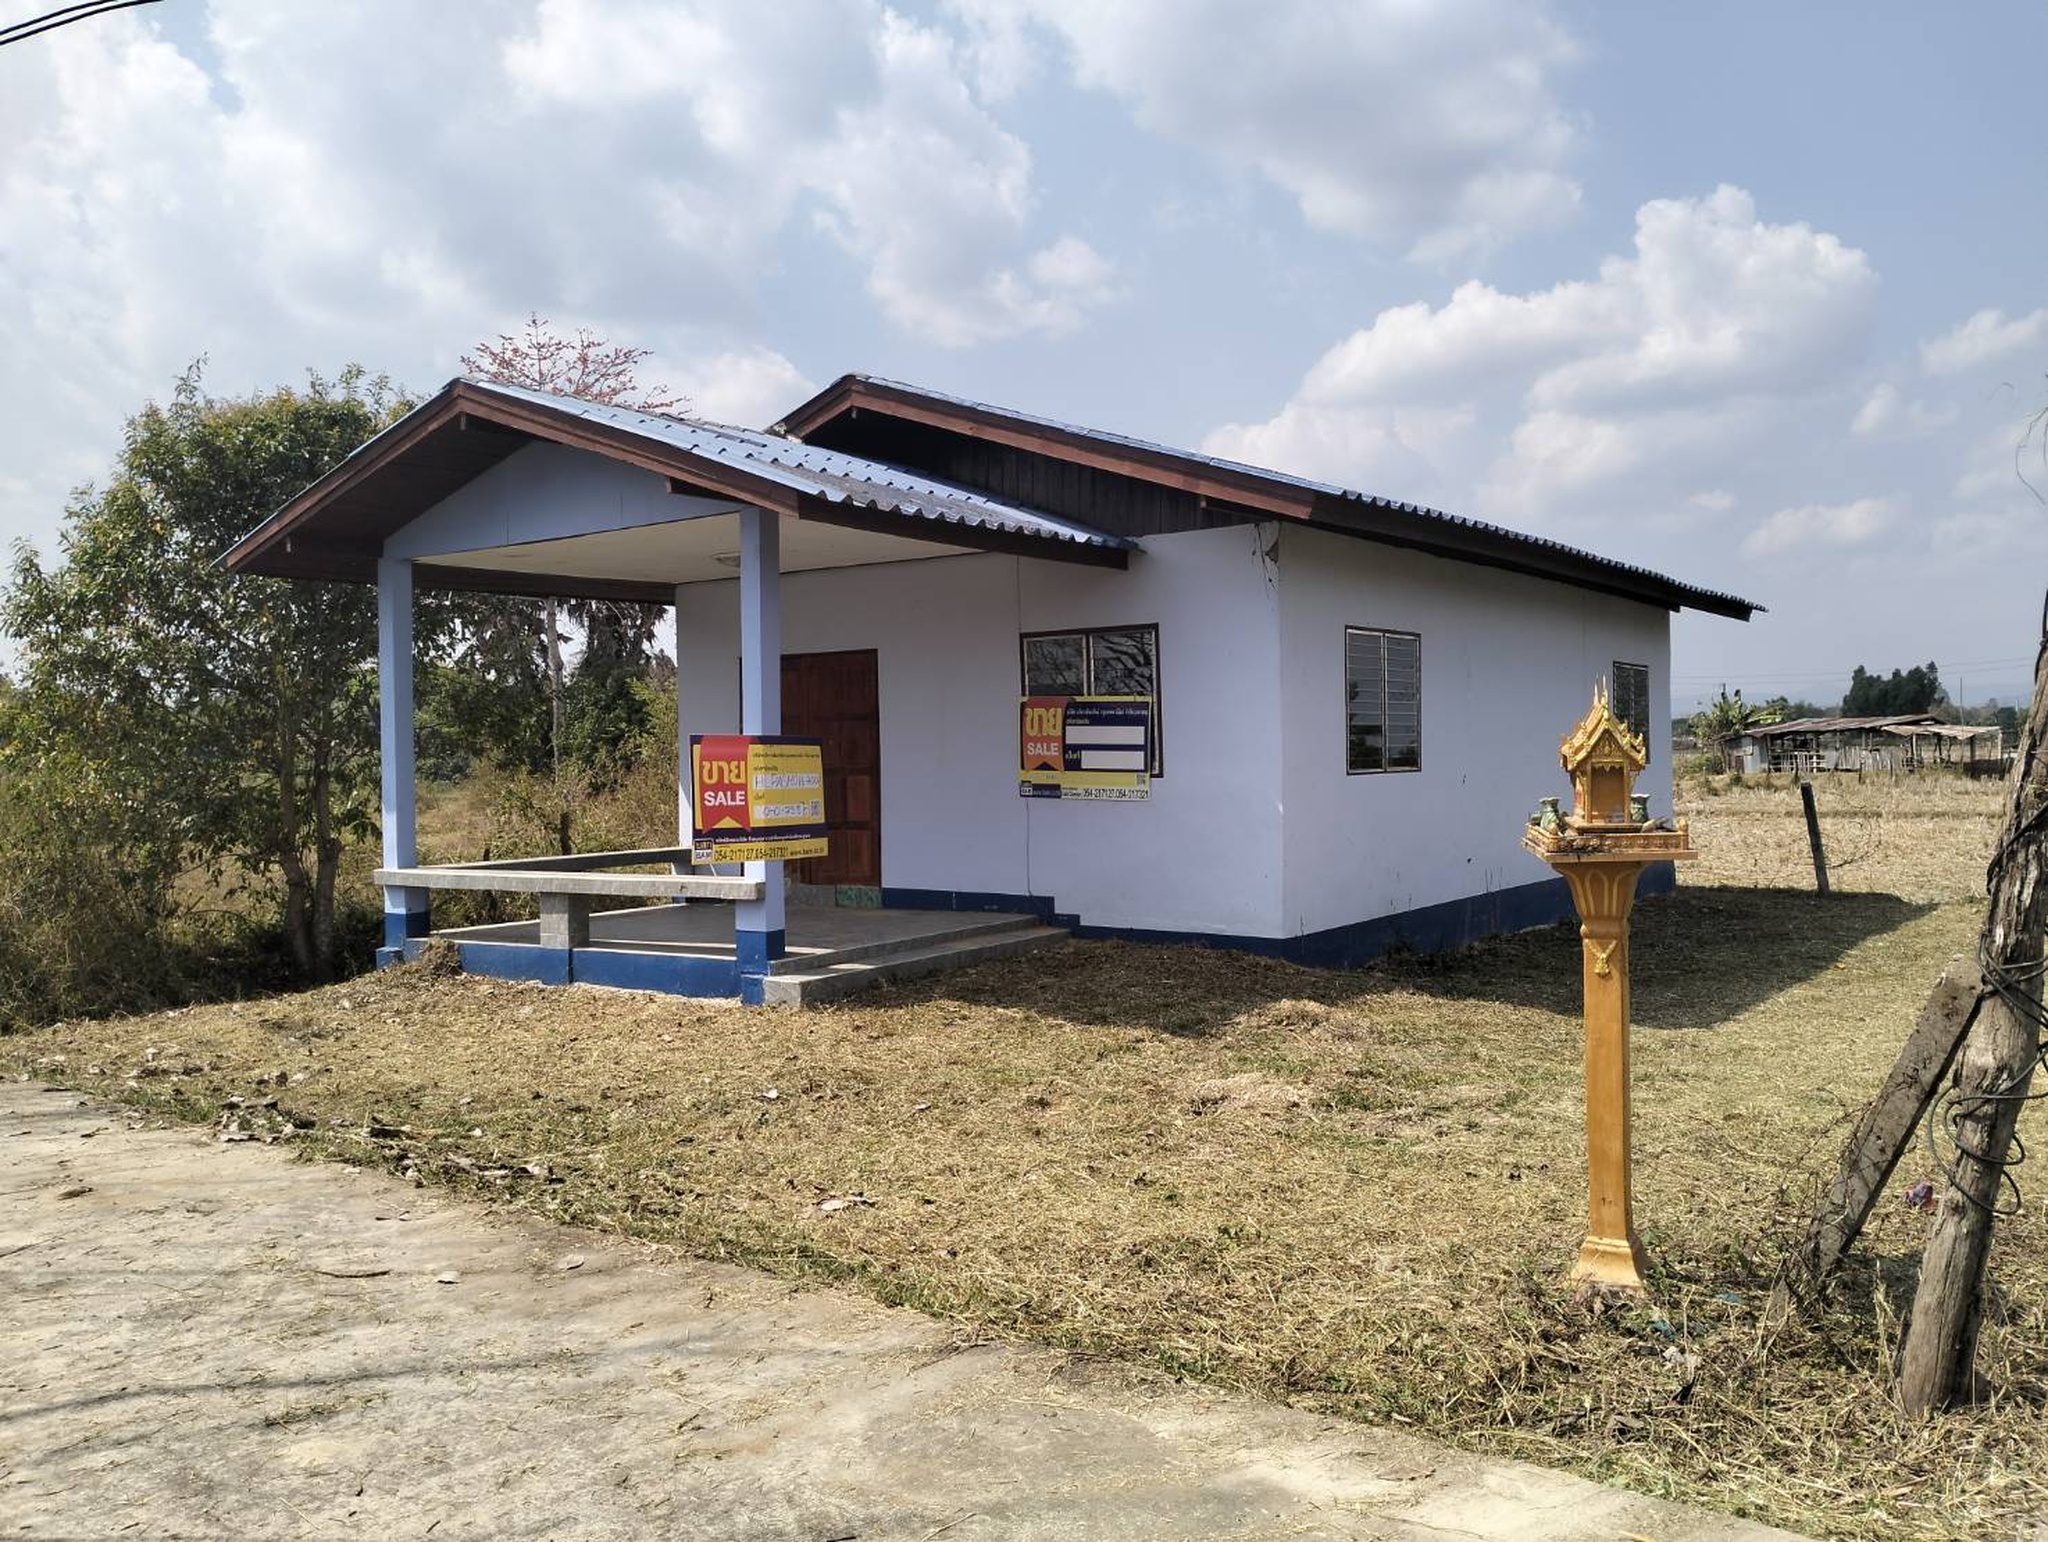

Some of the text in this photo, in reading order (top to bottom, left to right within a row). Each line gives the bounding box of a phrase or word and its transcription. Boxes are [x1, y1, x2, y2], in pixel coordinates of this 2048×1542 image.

[1025, 707, 1063, 736] ขาย
[1027, 742, 1059, 756] SALE
[702, 760, 746, 785] ขาย
[703, 790, 746, 806] SALE
